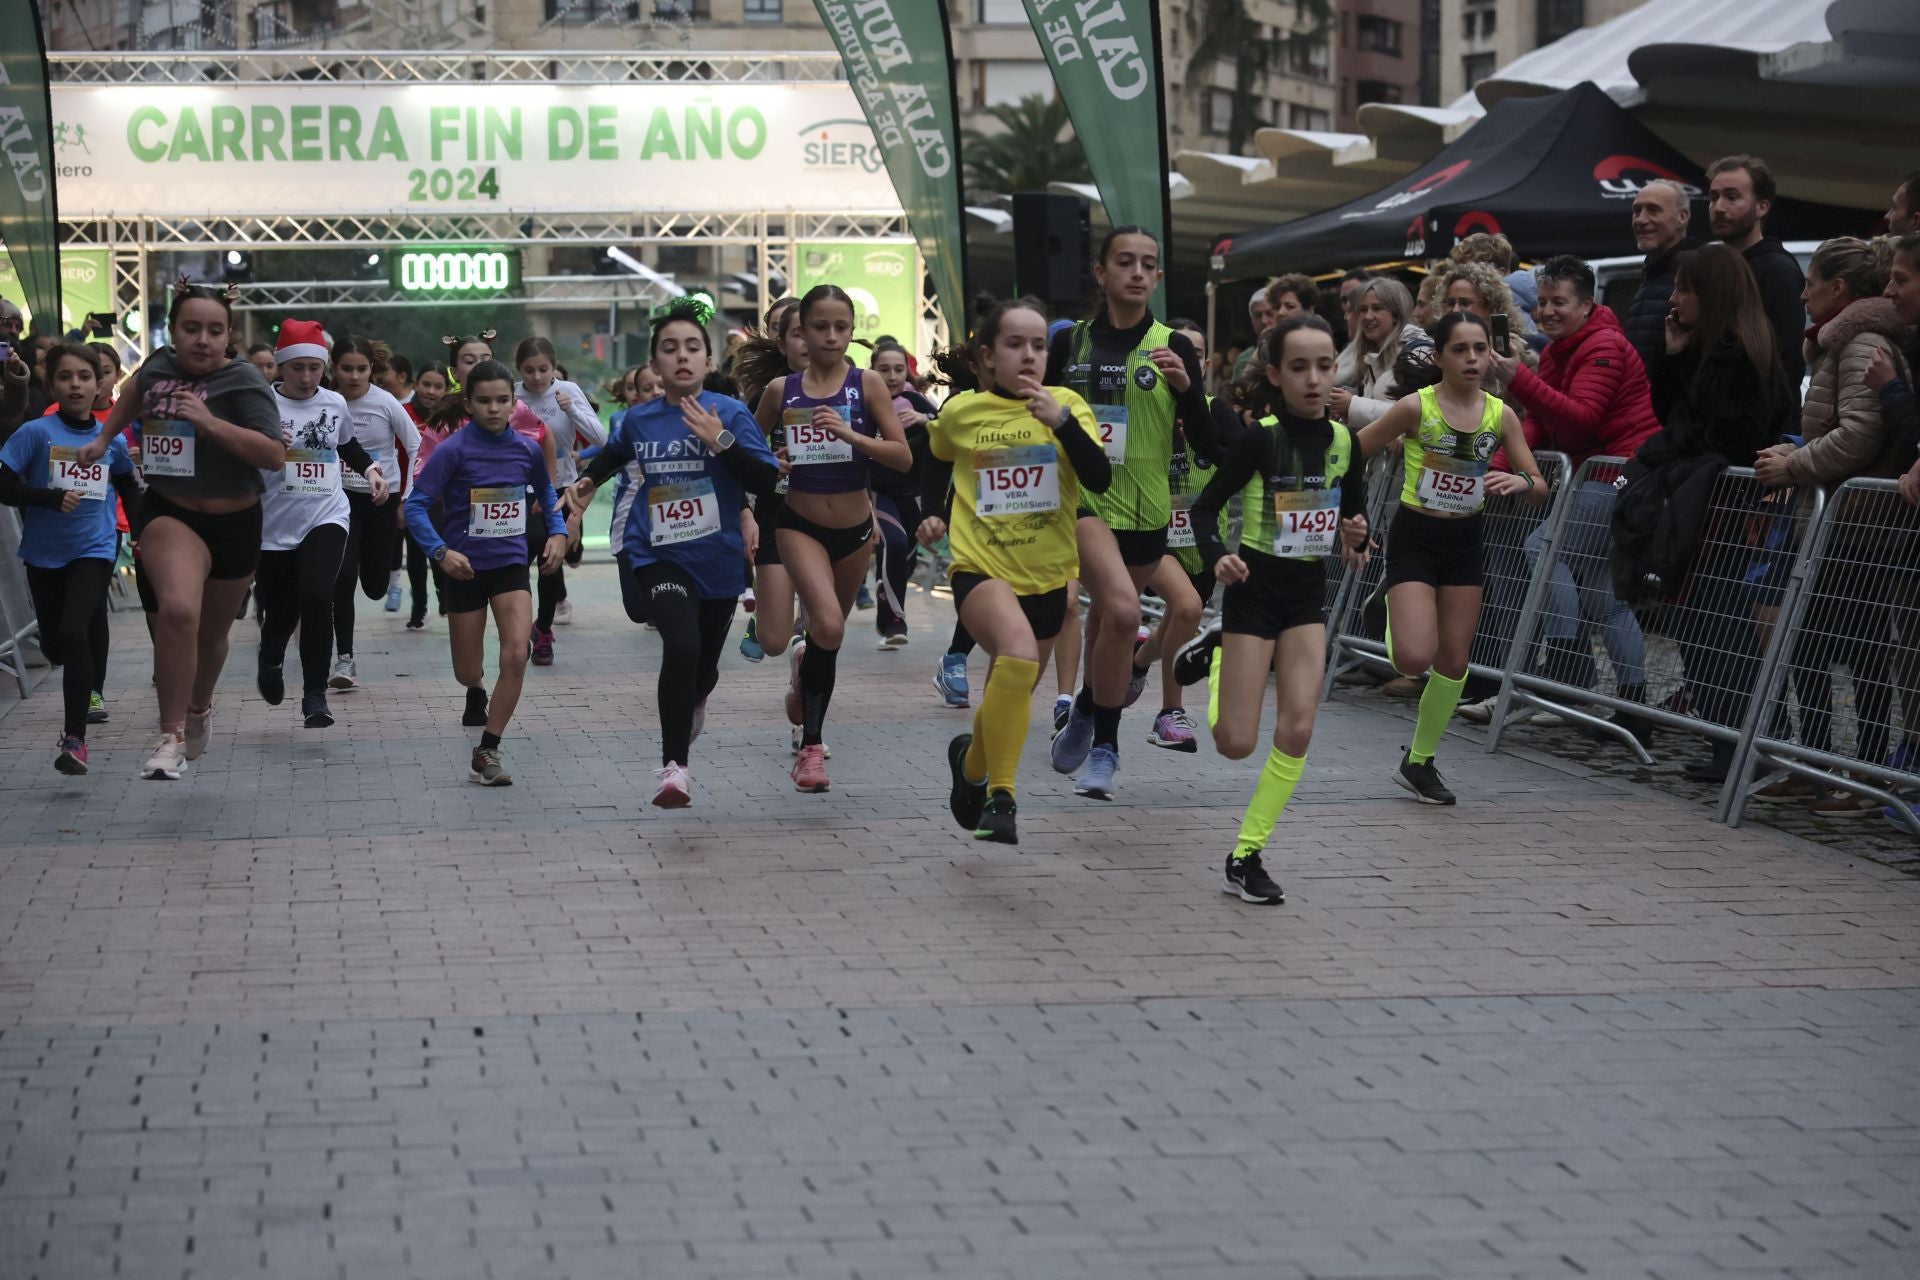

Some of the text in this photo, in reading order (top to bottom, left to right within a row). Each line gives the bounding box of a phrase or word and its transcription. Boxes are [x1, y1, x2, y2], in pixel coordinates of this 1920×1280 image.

[127, 97, 767, 163] CARRERA FIN DE AÑO
[408, 167, 499, 201] 2024
[146, 436, 183, 456] 1509
[59, 462, 102, 481] 1458
[295, 463, 325, 478] 1511
[986, 466, 1044, 491] 1507
[1431, 471, 1477, 495] 1552
[1005, 491, 1028, 499] VERA
[1435, 492, 1463, 502] MARINA
[482, 502, 520, 520] 1525
[657, 498, 704, 523] 1491
[669, 520, 696, 530] MIREIA
[1289, 509, 1336, 534] 1492
[1305, 534, 1325, 542] CLOE
